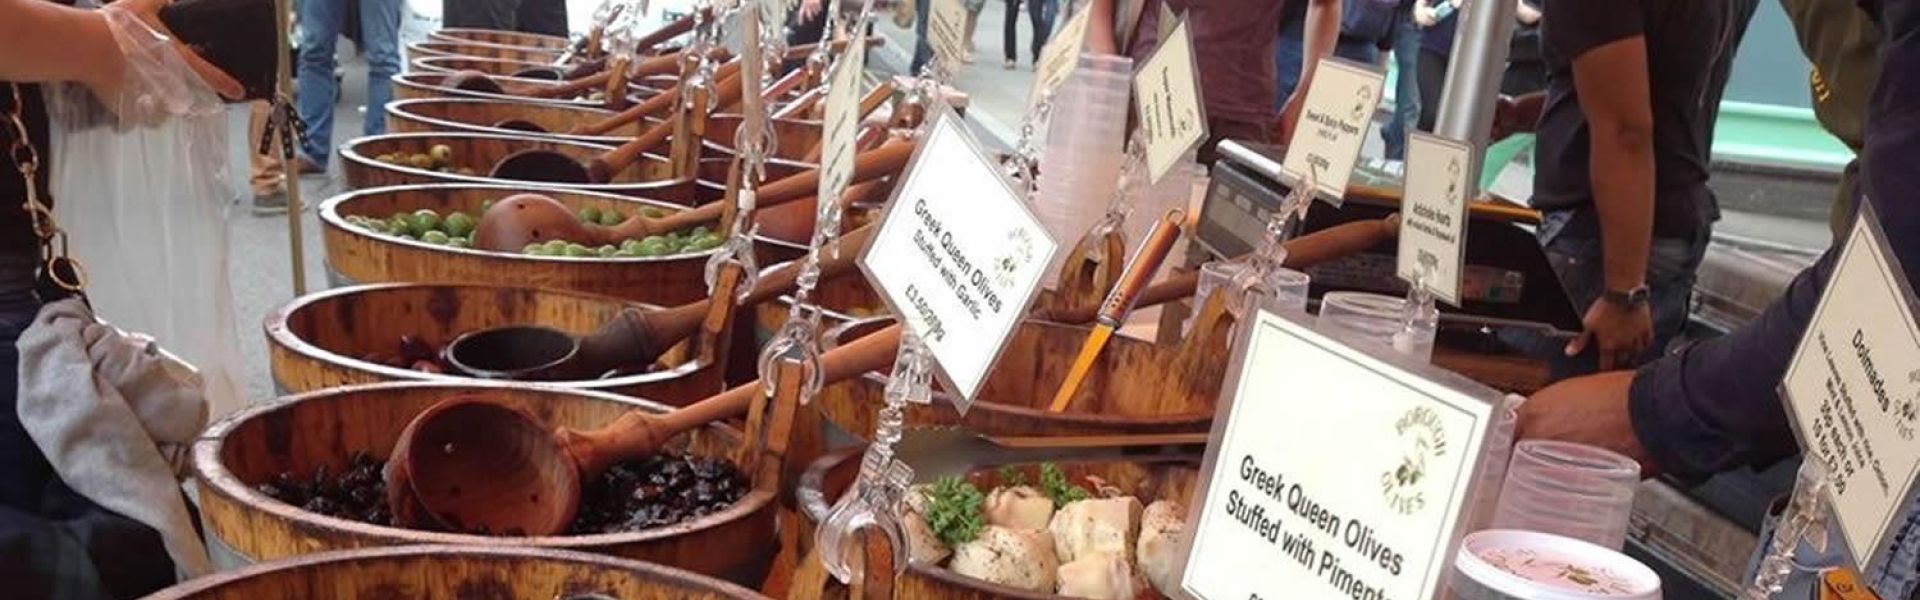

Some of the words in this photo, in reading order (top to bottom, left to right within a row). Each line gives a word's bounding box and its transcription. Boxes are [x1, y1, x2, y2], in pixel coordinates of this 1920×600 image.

[912, 229, 941, 270] Stuffed
[939, 264, 960, 290] with
[955, 280, 981, 320] Garlic
[914, 198, 943, 238] Greek
[940, 230, 972, 276] Queen
[970, 268, 1002, 314] Olives
[1852, 328, 1890, 413] Dolmades
[1394, 405, 1448, 457] BOROUGH
[1819, 434, 1830, 457] for
[1839, 382, 1856, 419] Stuffed
[1854, 418, 1865, 439] with
[1830, 426, 1847, 461] each
[1844, 460, 1854, 477] or
[1239, 454, 1285, 502] Greek
[1287, 484, 1341, 538] Queen
[1344, 519, 1405, 576] Olives
[1382, 472, 1426, 515] OLIVES
[1225, 489, 1280, 544] Stuffed
[1281, 530, 1316, 571] with
[1317, 551, 1398, 600] Piment
